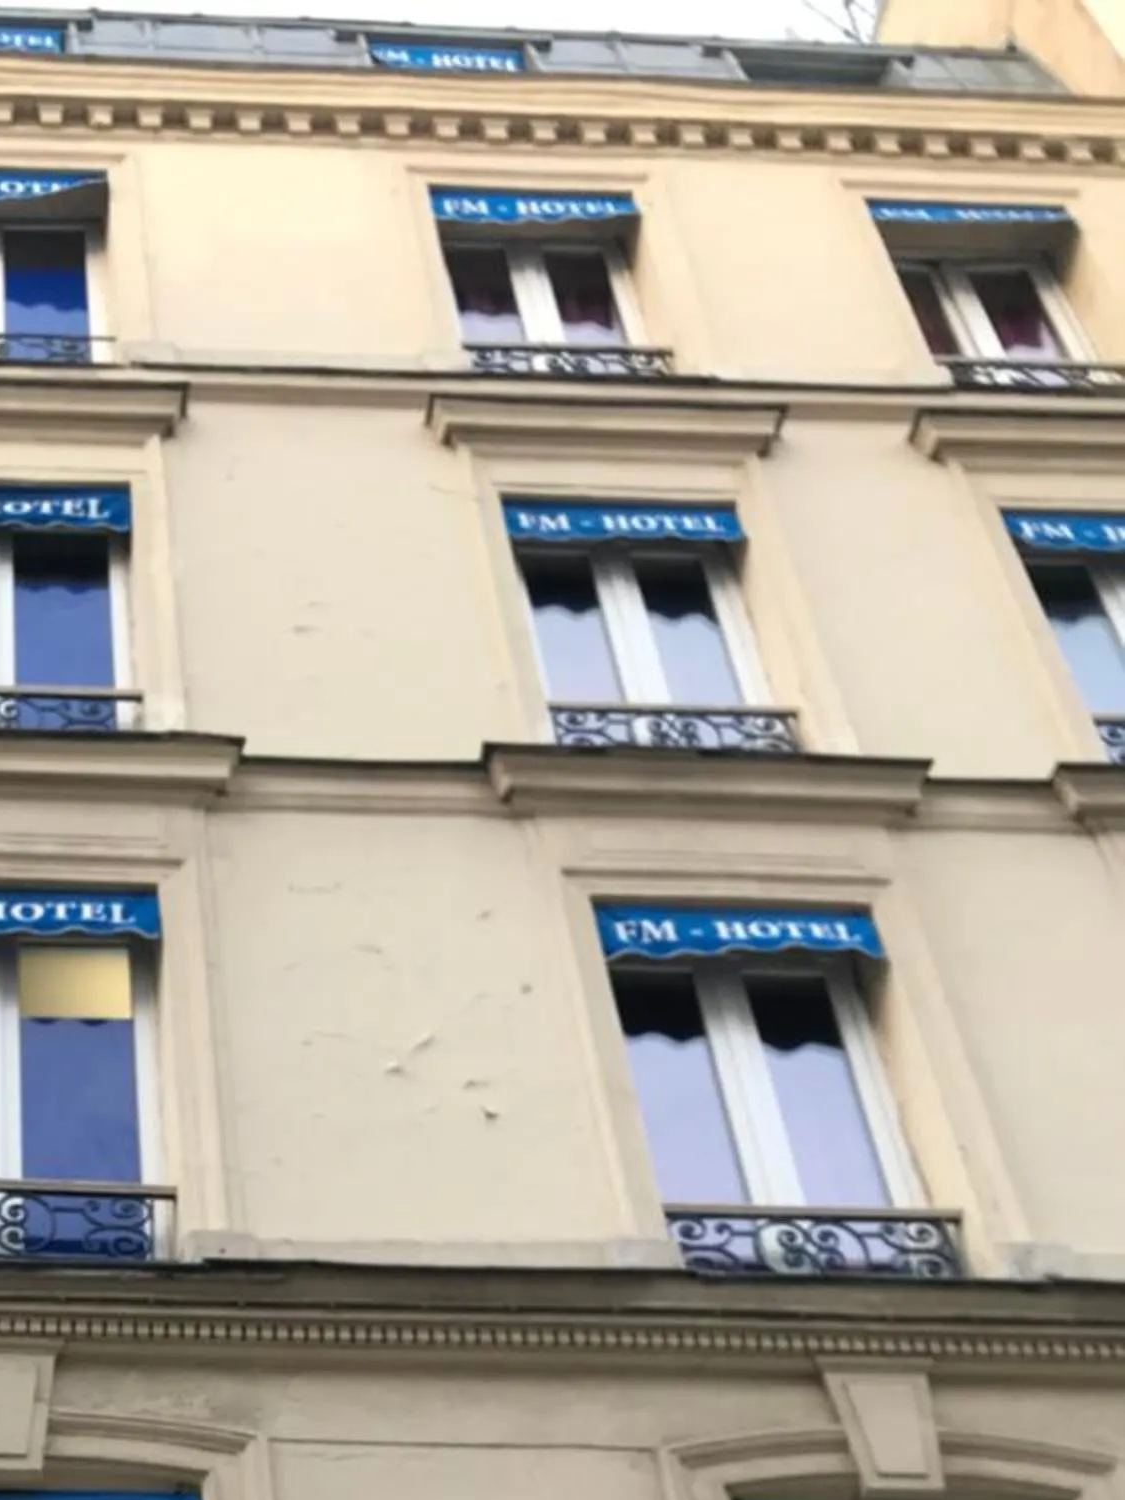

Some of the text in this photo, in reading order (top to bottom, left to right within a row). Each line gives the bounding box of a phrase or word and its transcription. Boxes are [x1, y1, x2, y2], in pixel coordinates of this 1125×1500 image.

[516, 511, 572, 532] FM
[601, 513, 725, 533] HOTEL
[1018, 519, 1075, 541] FM
[613, 918, 679, 944] FM
[712, 919, 862, 942] HOTEL
